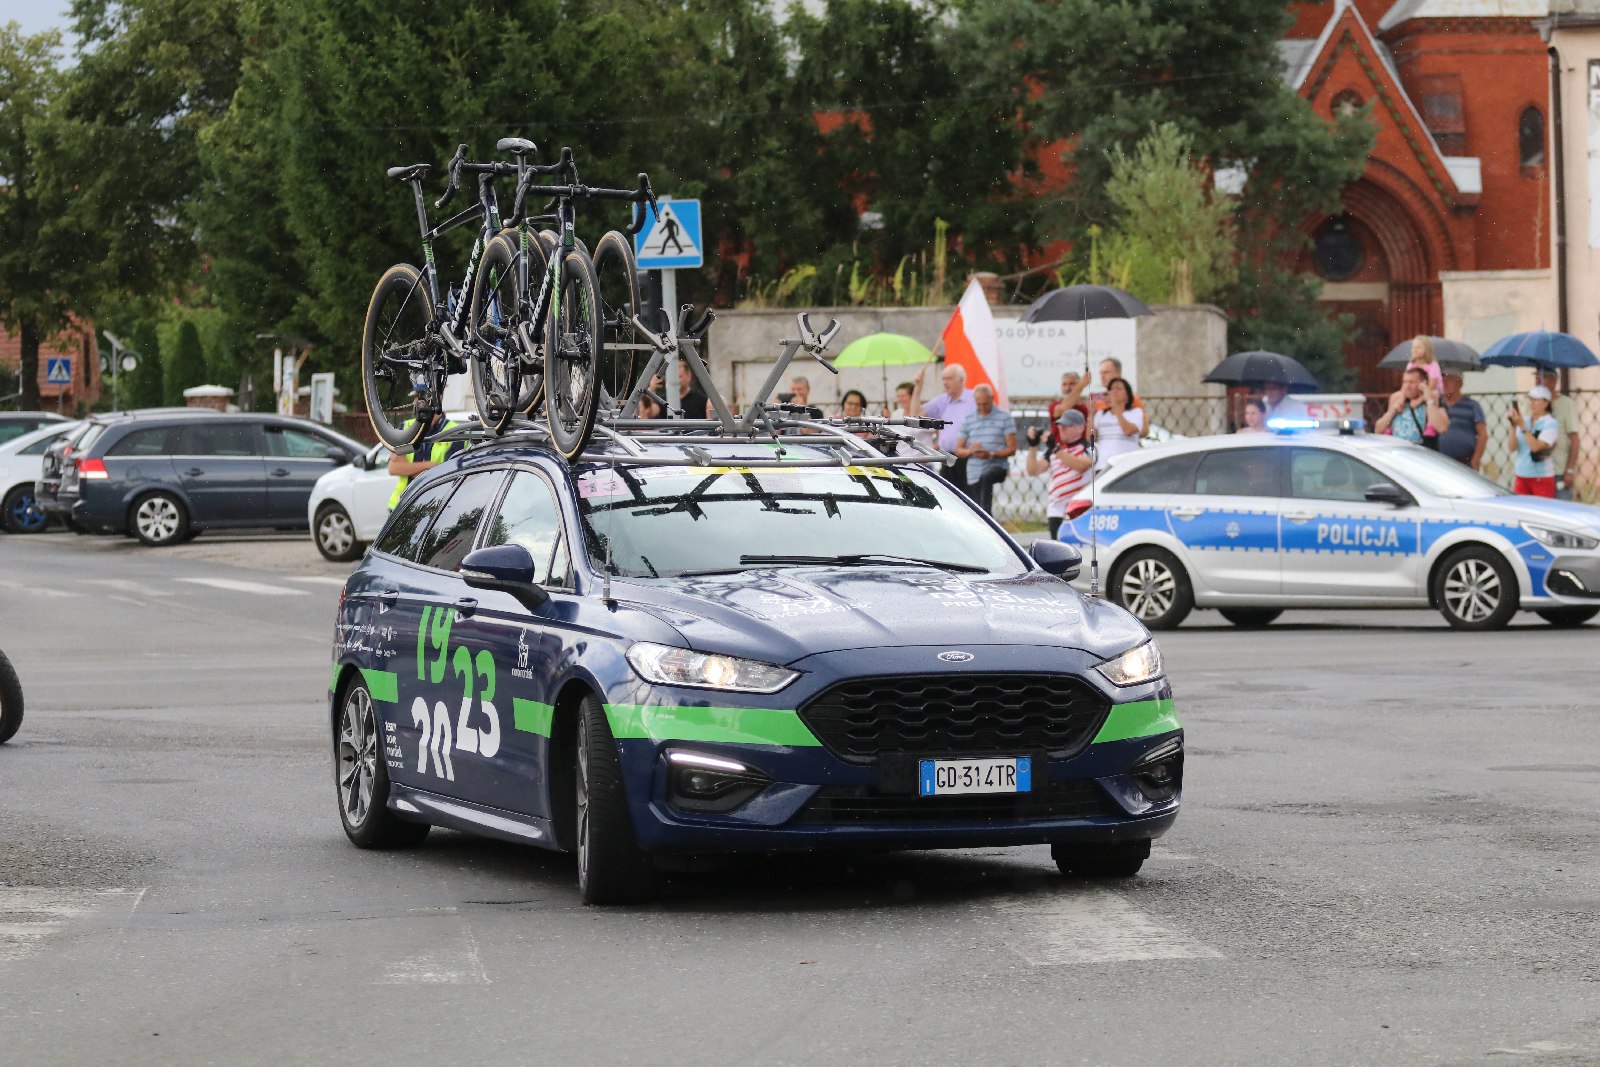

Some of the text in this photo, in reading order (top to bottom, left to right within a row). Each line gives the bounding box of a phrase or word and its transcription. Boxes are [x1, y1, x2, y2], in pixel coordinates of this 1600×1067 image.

[995, 327, 1066, 338] OGOPEDA
[1316, 522, 1399, 548] POLICJA
[928, 591, 1066, 607] nordisk
[802, 602, 873, 616] nordisk
